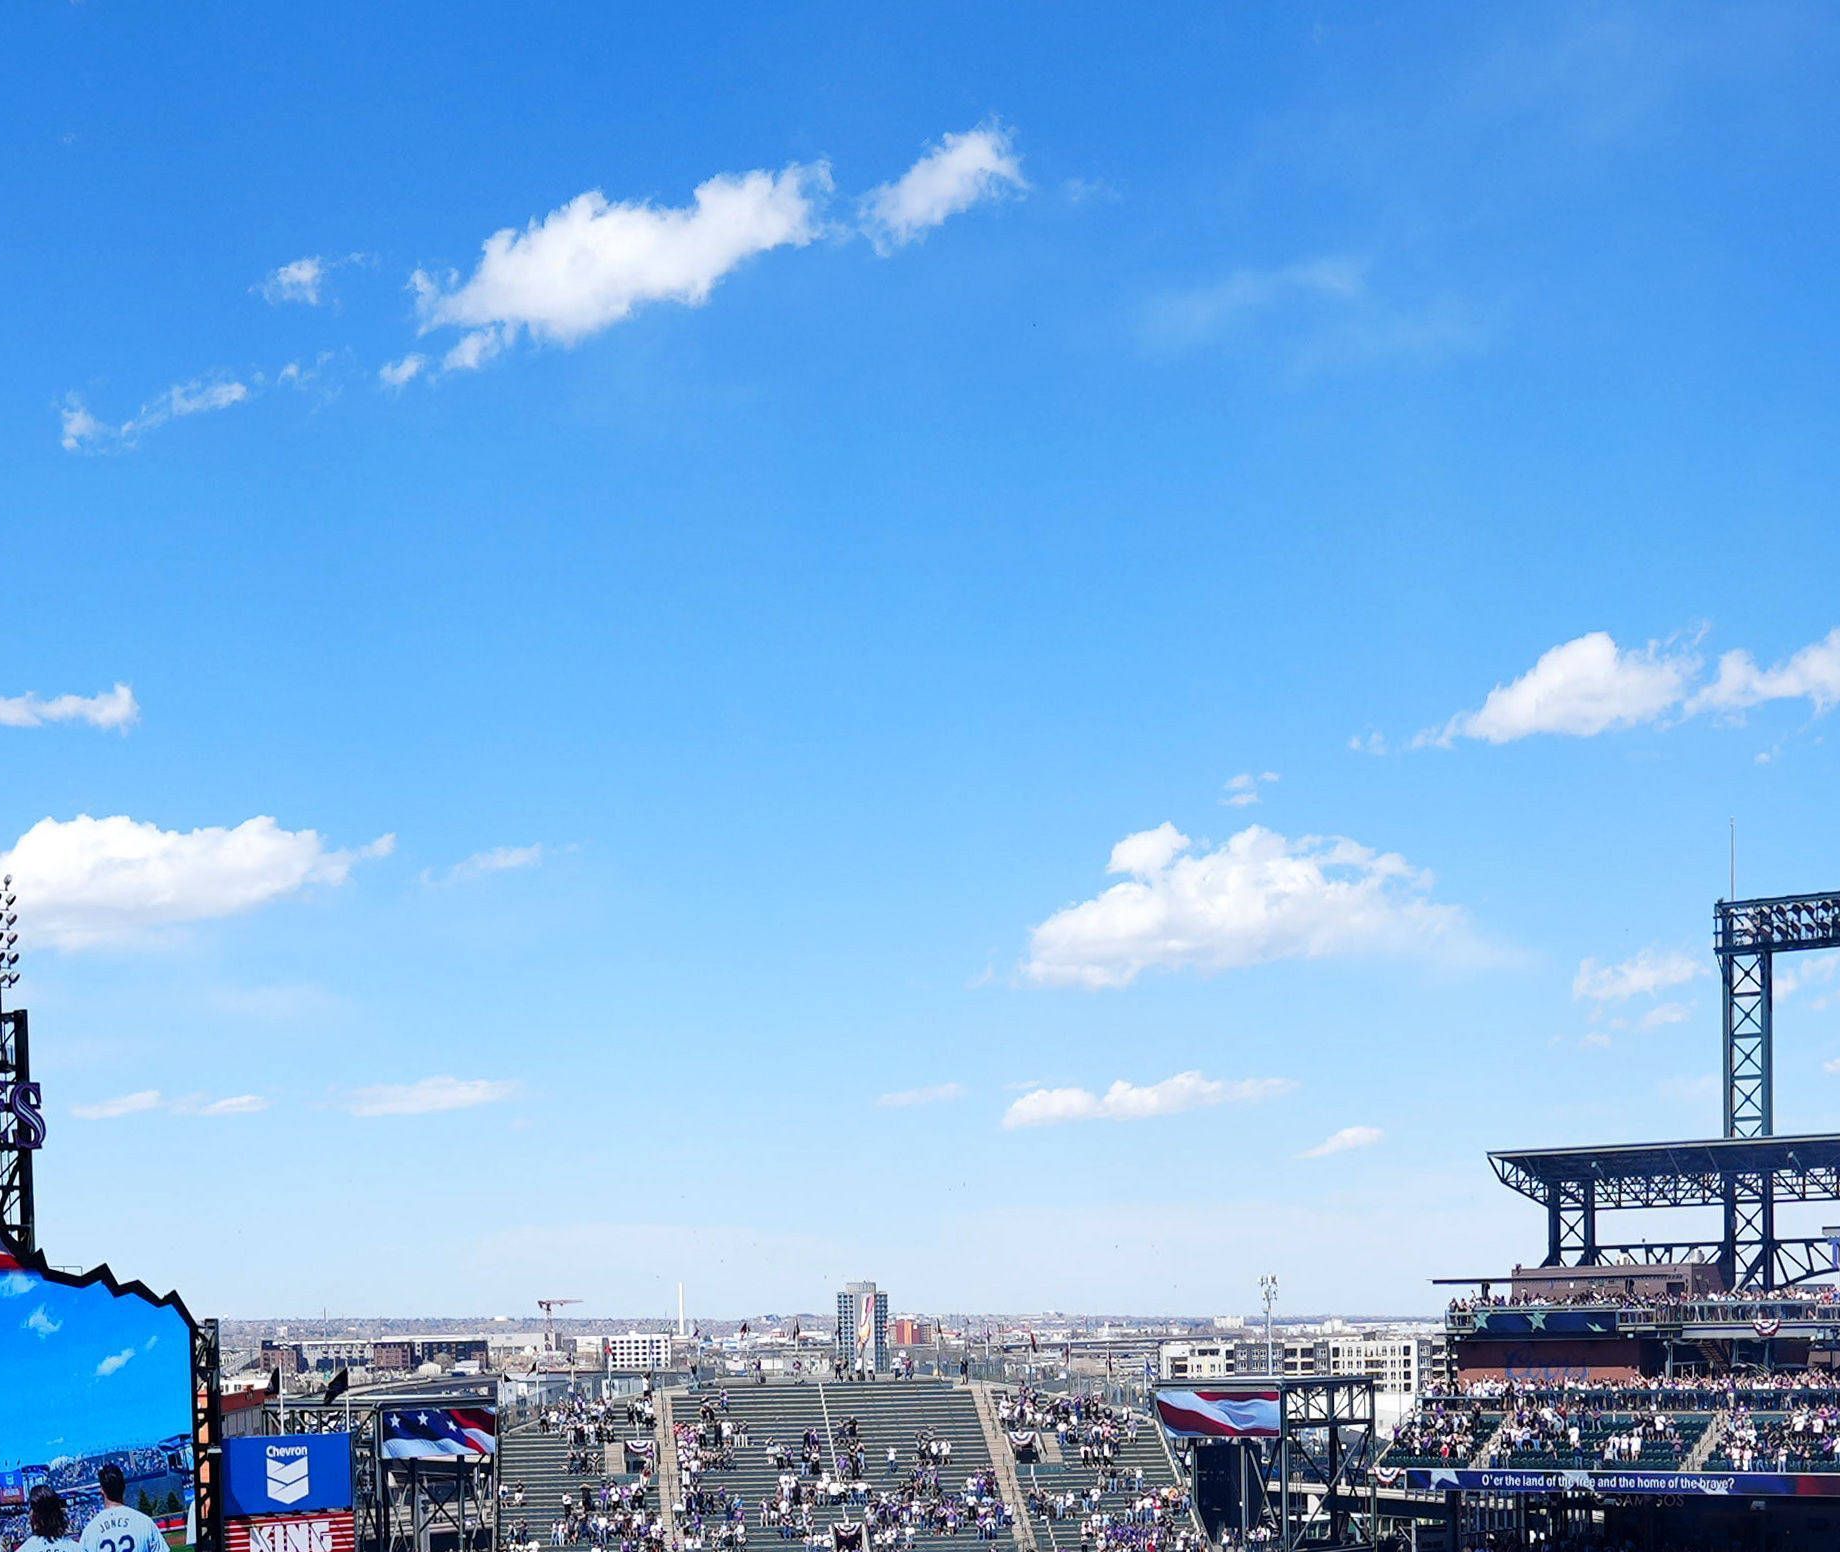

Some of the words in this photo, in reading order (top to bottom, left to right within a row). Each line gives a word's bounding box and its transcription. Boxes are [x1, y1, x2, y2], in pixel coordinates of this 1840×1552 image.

[266, 1445, 308, 1457] Chevron
[1504, 1475, 1521, 1486] the
[1522, 1475, 1544, 1487] land
[1546, 1475, 1557, 1487] of
[1558, 1476, 1574, 1488] the
[1598, 1476, 1617, 1488] and
[1619, 1476, 1636, 1488] the
[1637, 1477, 1666, 1489] home
[1668, 1477, 1679, 1489] of
[1680, 1478, 1697, 1490] the
[98, 1517, 130, 1534] JONES
